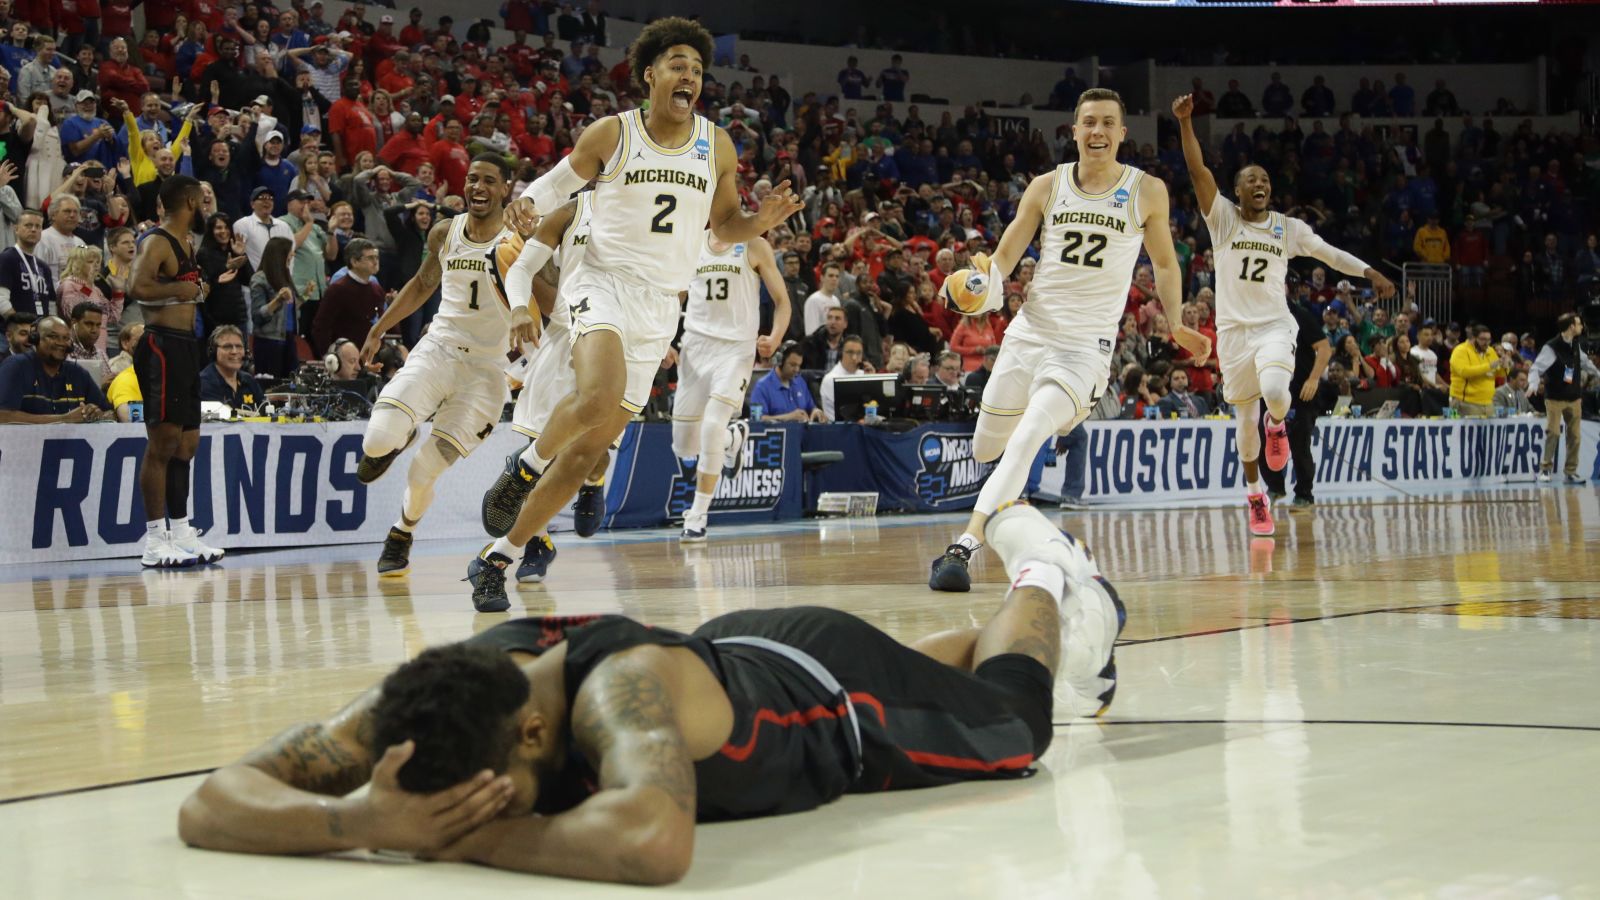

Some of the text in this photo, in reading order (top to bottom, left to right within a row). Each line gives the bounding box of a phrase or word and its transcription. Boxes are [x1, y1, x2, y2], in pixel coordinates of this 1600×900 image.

[624, 168, 708, 194] MICHIGAN
[651, 193, 678, 234] 2
[1052, 212, 1127, 234] MICHIGAN
[1060, 231, 1108, 269] 22
[1231, 241, 1283, 258] MICHIGAN
[447, 259, 487, 272] MICHI
[696, 264, 741, 275] MICHIGAN
[1239, 256, 1269, 283] 12
[468, 280, 480, 311] 1
[705, 278, 729, 301] 13
[1090, 427, 1213, 496] HOSTED
[1221, 427, 1247, 489] B
[1382, 425, 1453, 481] STATE
[1460, 423, 1564, 478] UNIVERST
